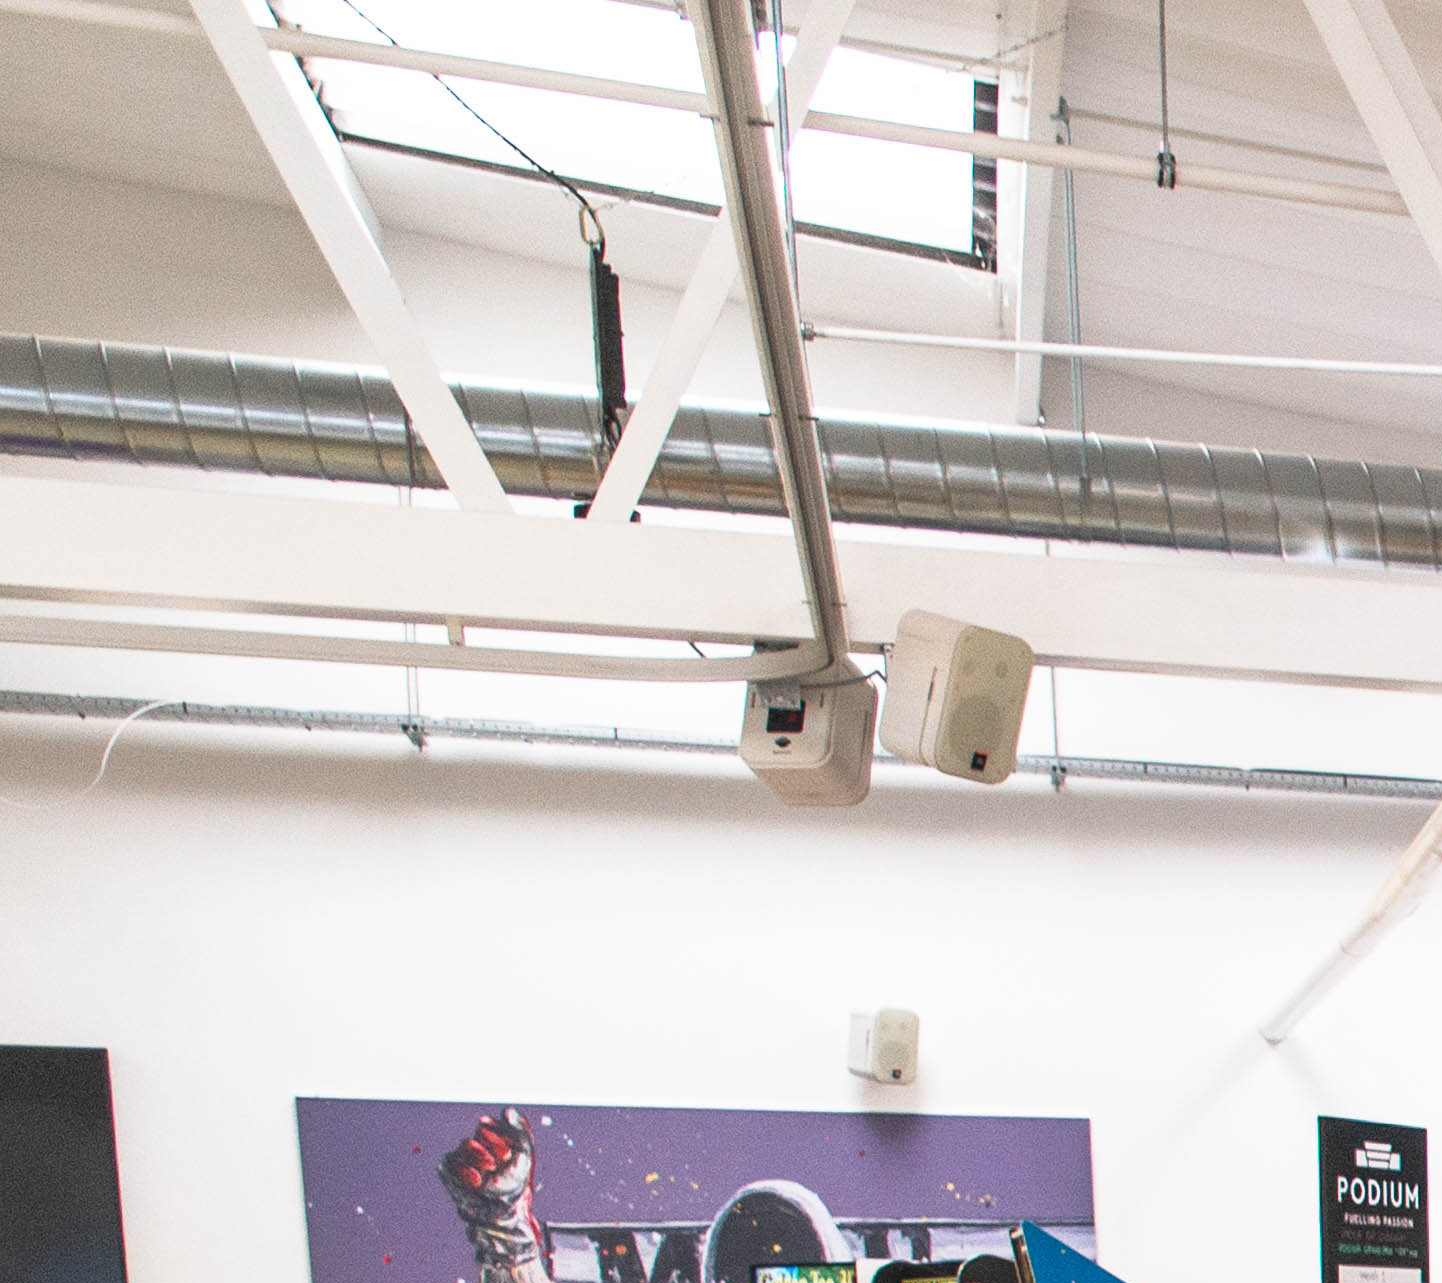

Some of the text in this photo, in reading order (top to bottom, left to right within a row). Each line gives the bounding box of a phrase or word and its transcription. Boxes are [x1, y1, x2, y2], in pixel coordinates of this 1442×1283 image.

[1337, 1175, 1420, 1209] PODIUM
[1344, 1212, 1414, 1228] FUELLING PASSION
